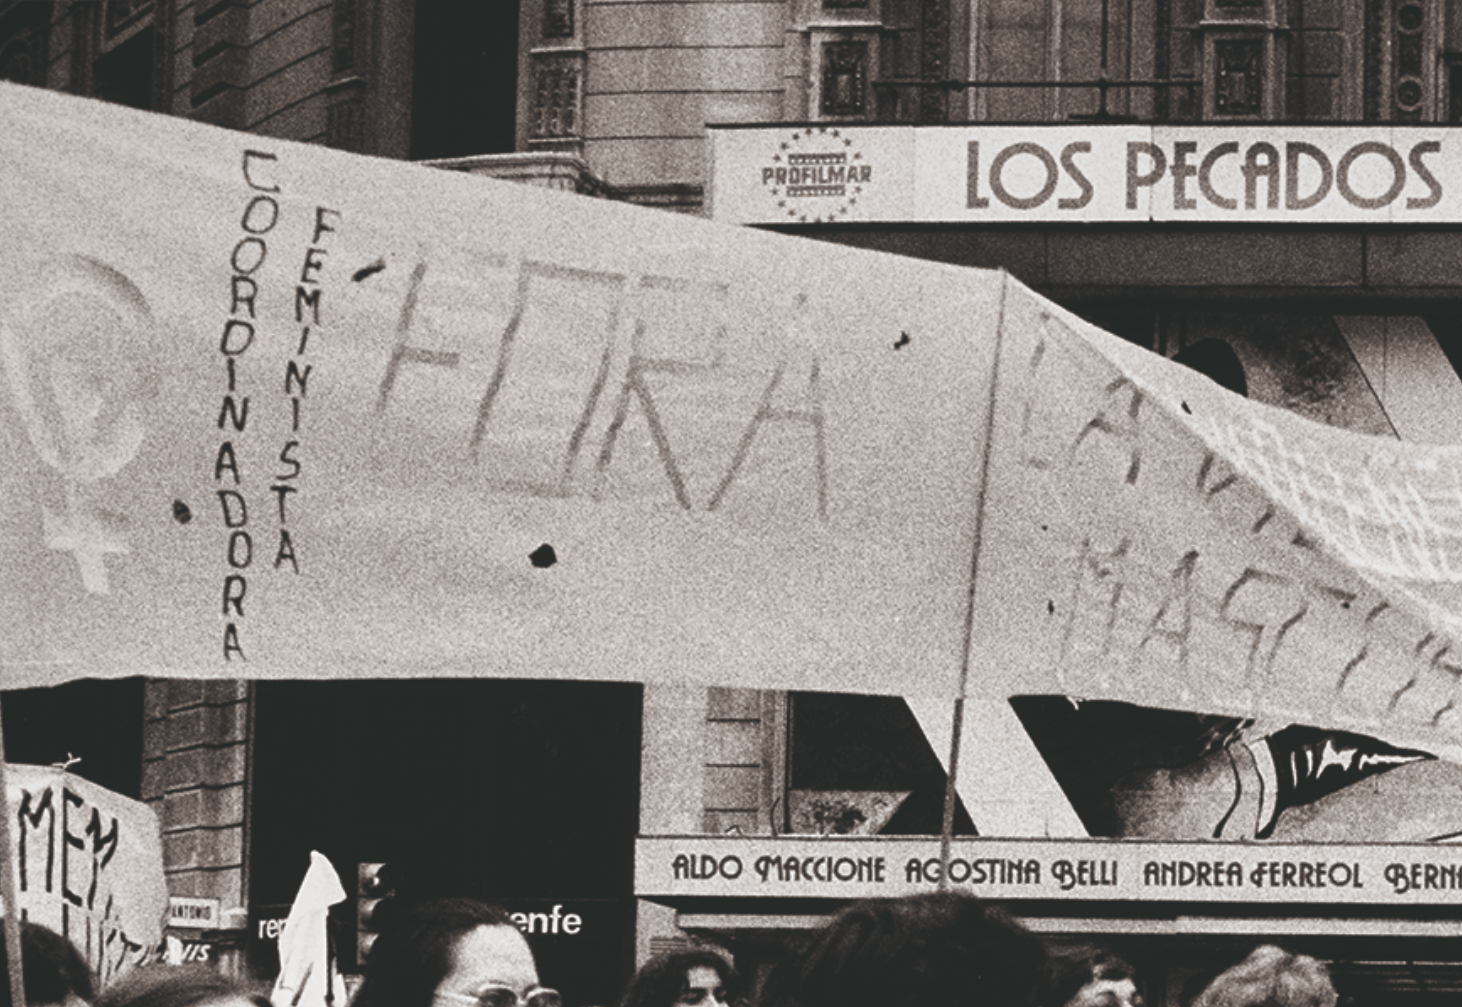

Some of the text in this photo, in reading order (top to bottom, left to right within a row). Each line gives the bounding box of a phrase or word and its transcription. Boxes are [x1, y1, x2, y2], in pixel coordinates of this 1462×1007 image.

[762, 165, 872, 185] PROFILMAR
[966, 140, 1093, 211] LOS
[1125, 140, 1443, 211] PECADOS
[213, 150, 281, 661] COORDINADORA
[270, 207, 342, 574] FEMINISTA
[671, 853, 743, 881] ALDO
[754, 855, 886, 883] MACCIONE
[905, 858, 1041, 885] AGOSTINA
[1051, 860, 1118, 890] BELLI
[1143, 860, 1243, 888] ANDREA
[1249, 861, 1364, 889] FERREOL
[504, 903, 583, 935] enfe
[162, 943, 212, 961] VIS
